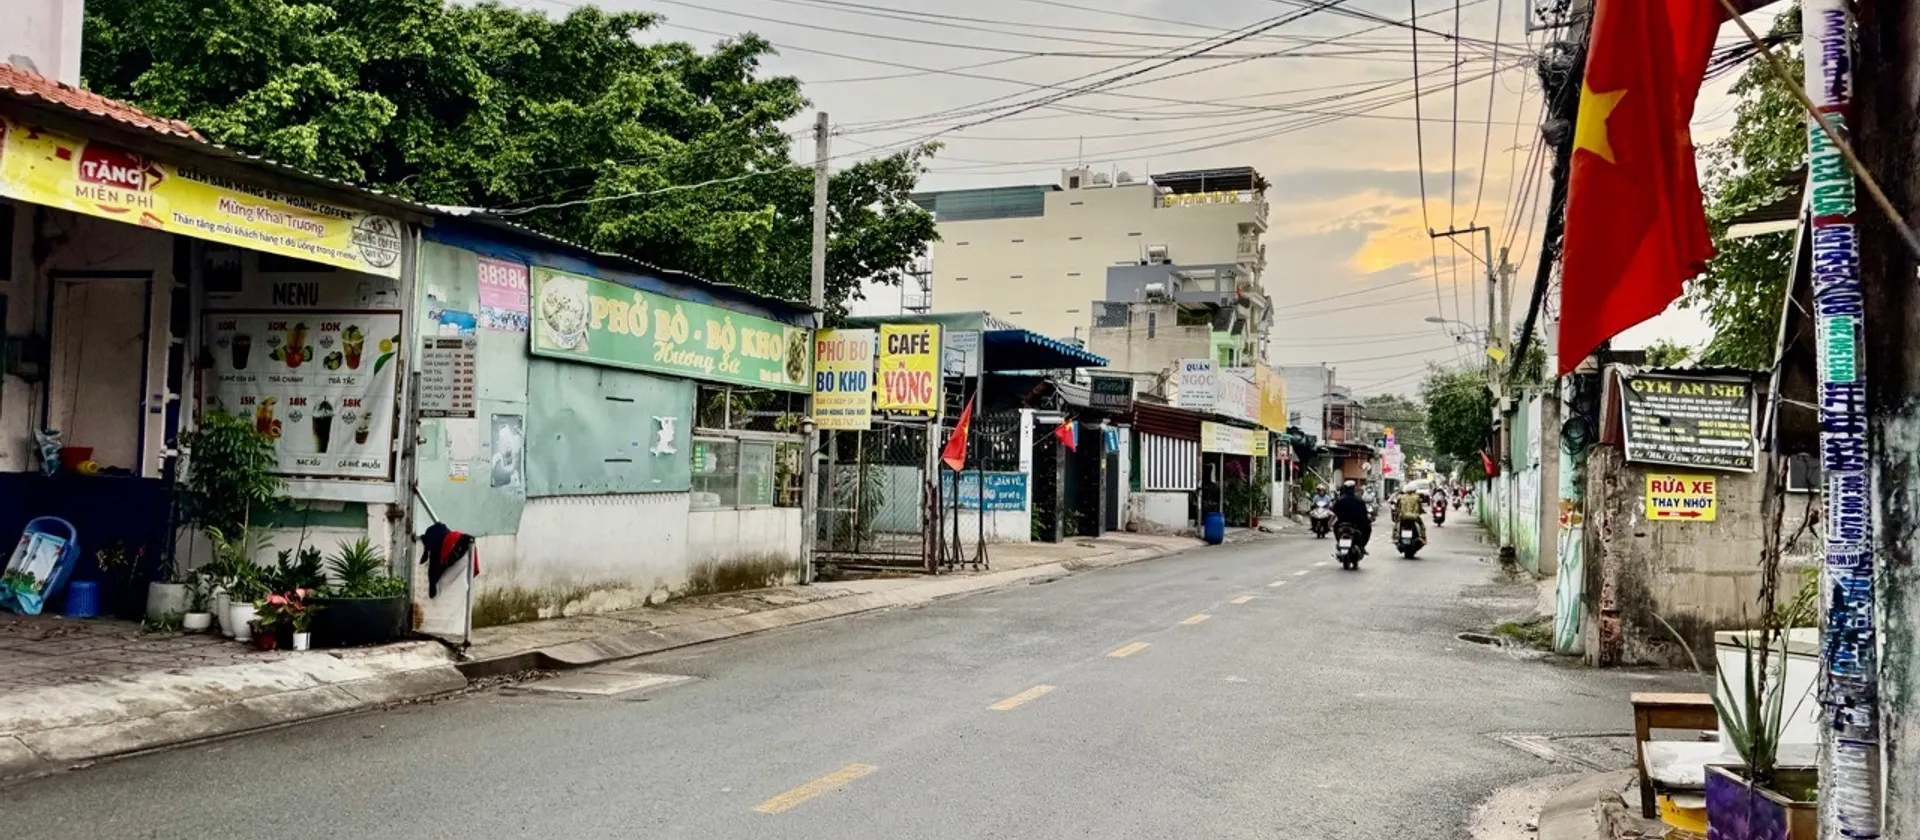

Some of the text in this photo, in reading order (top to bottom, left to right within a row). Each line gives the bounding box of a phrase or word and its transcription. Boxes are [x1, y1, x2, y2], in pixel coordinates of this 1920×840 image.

[82, 160, 141, 185] TẶNG
[257, 207, 283, 225] Khai
[320, 204, 353, 221] COFFEE
[479, 262, 527, 291] 8888k
[273, 282, 320, 306] MENU
[268, 321, 288, 331] 10K
[320, 321, 341, 332] 10K
[590, 291, 649, 337] PHỞ
[654, 304, 689, 344] BÒ
[741, 326, 784, 362] KHO
[1828, 318, 1853, 336] 200
[817, 334, 868, 362] PHỞ BÒ
[888, 329, 930, 355] CAFÉ
[1828, 337, 1853, 356] 500
[1828, 357, 1854, 381] 0933
[816, 366, 867, 392] BÒ KHO
[1630, 379, 1745, 398] GYM AN NHI
[1651, 475, 1713, 494] RỬA XE
[1652, 497, 1680, 508] THAY
